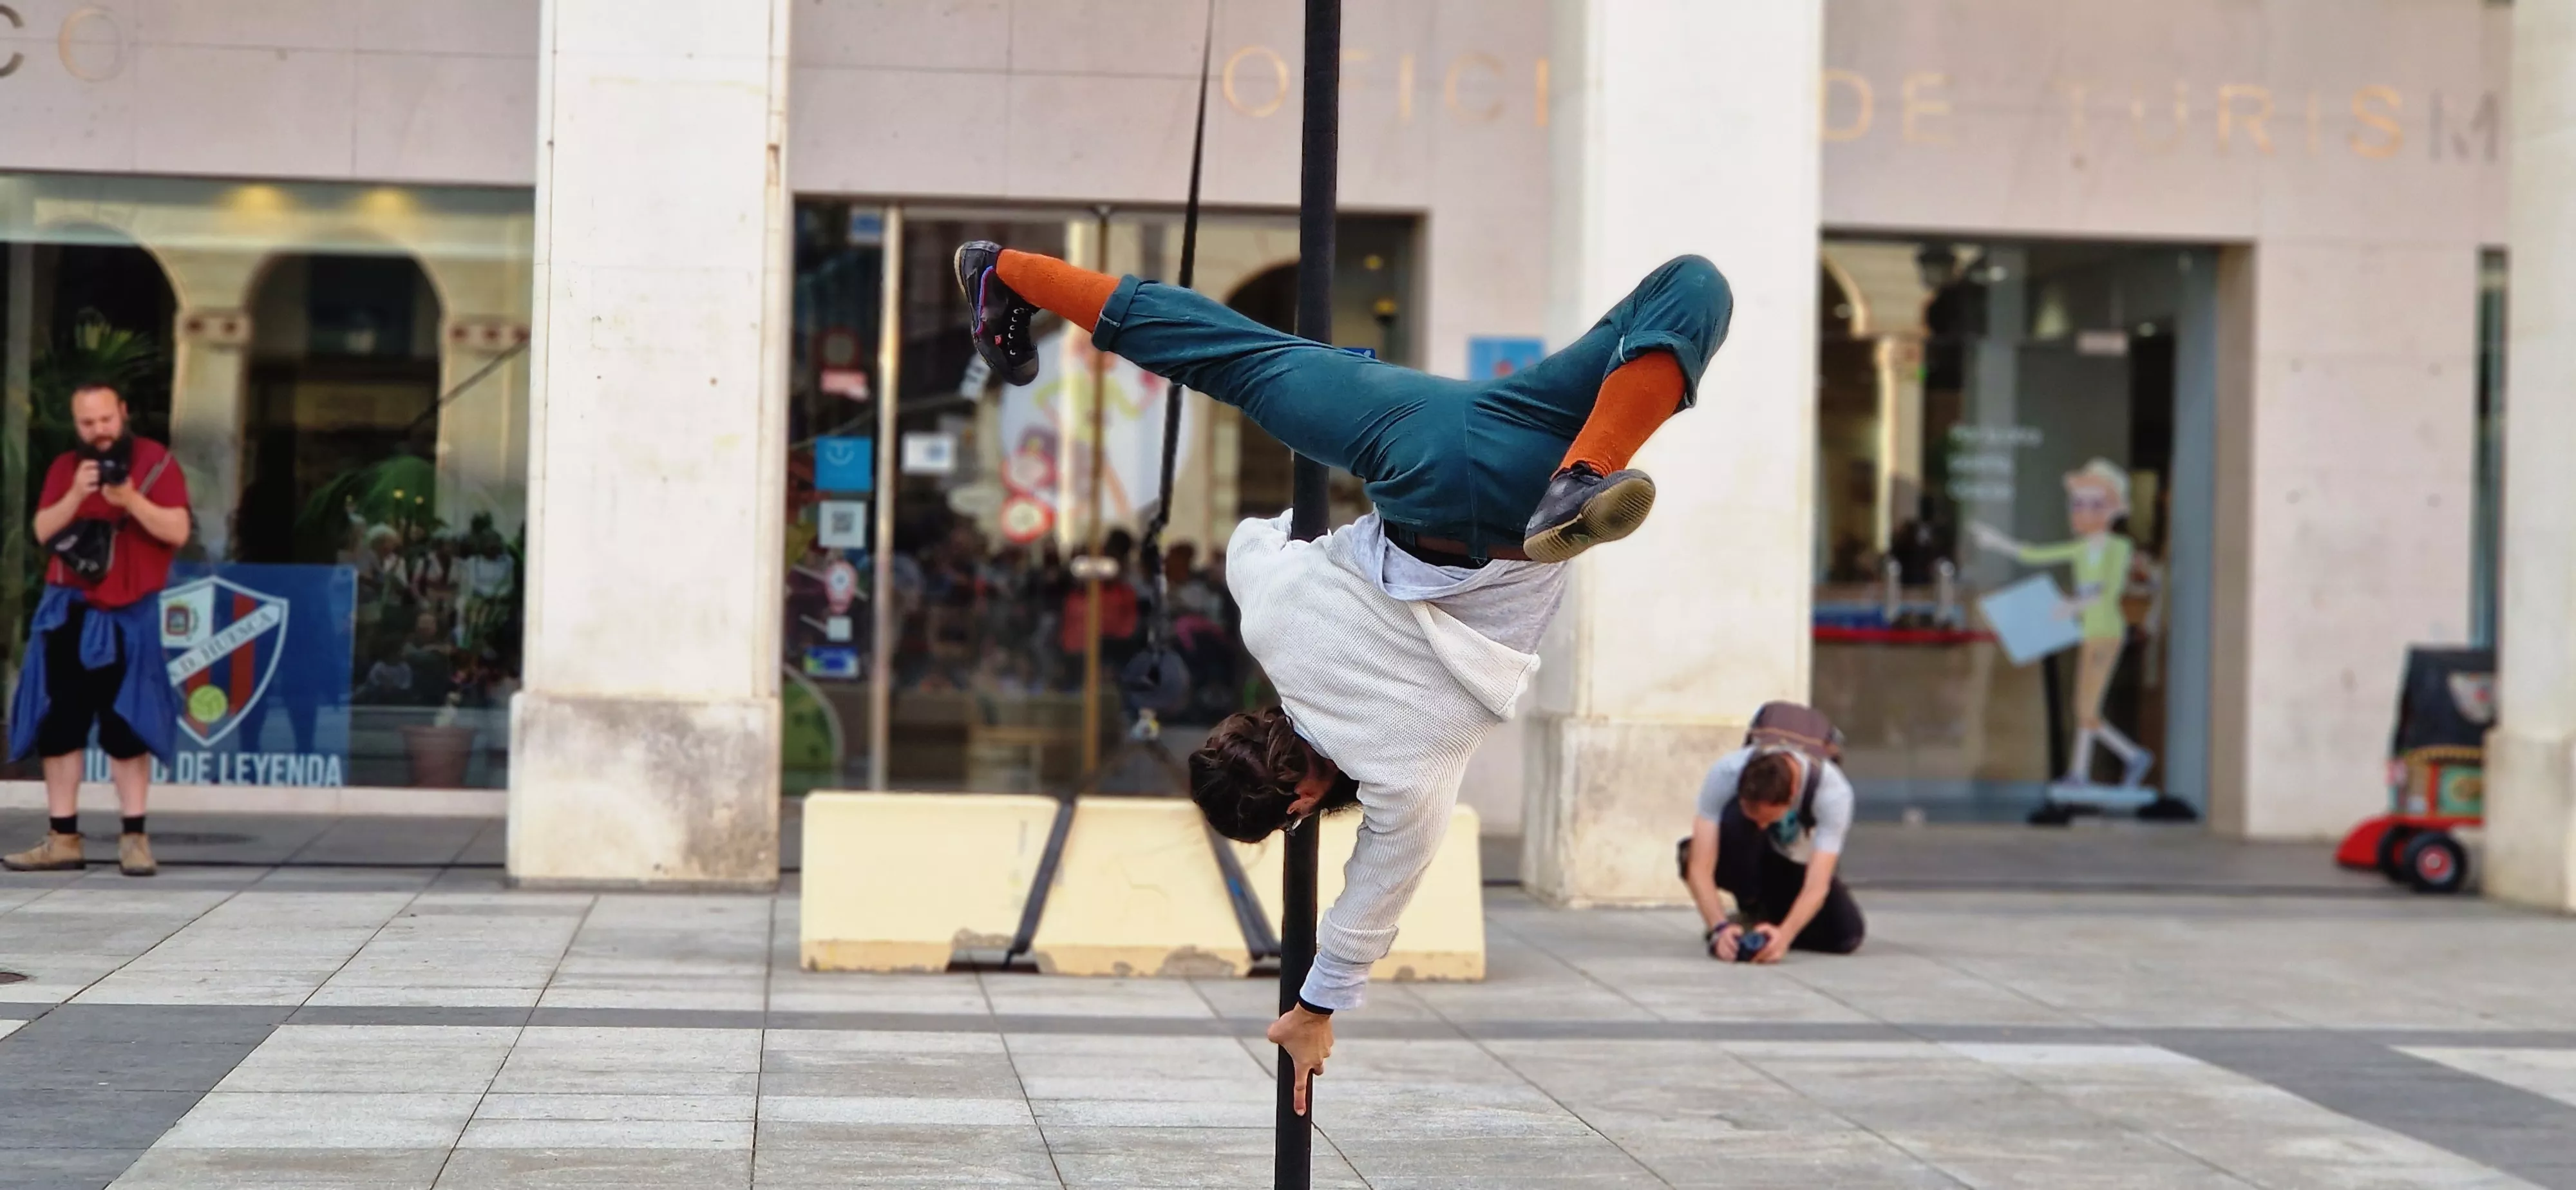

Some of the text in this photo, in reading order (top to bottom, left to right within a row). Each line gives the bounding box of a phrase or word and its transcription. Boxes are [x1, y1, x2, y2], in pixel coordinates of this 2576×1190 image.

[1817, 69, 1951, 146] DE
[178, 751, 213, 784] DE
[220, 752, 343, 788] LEYENDA
